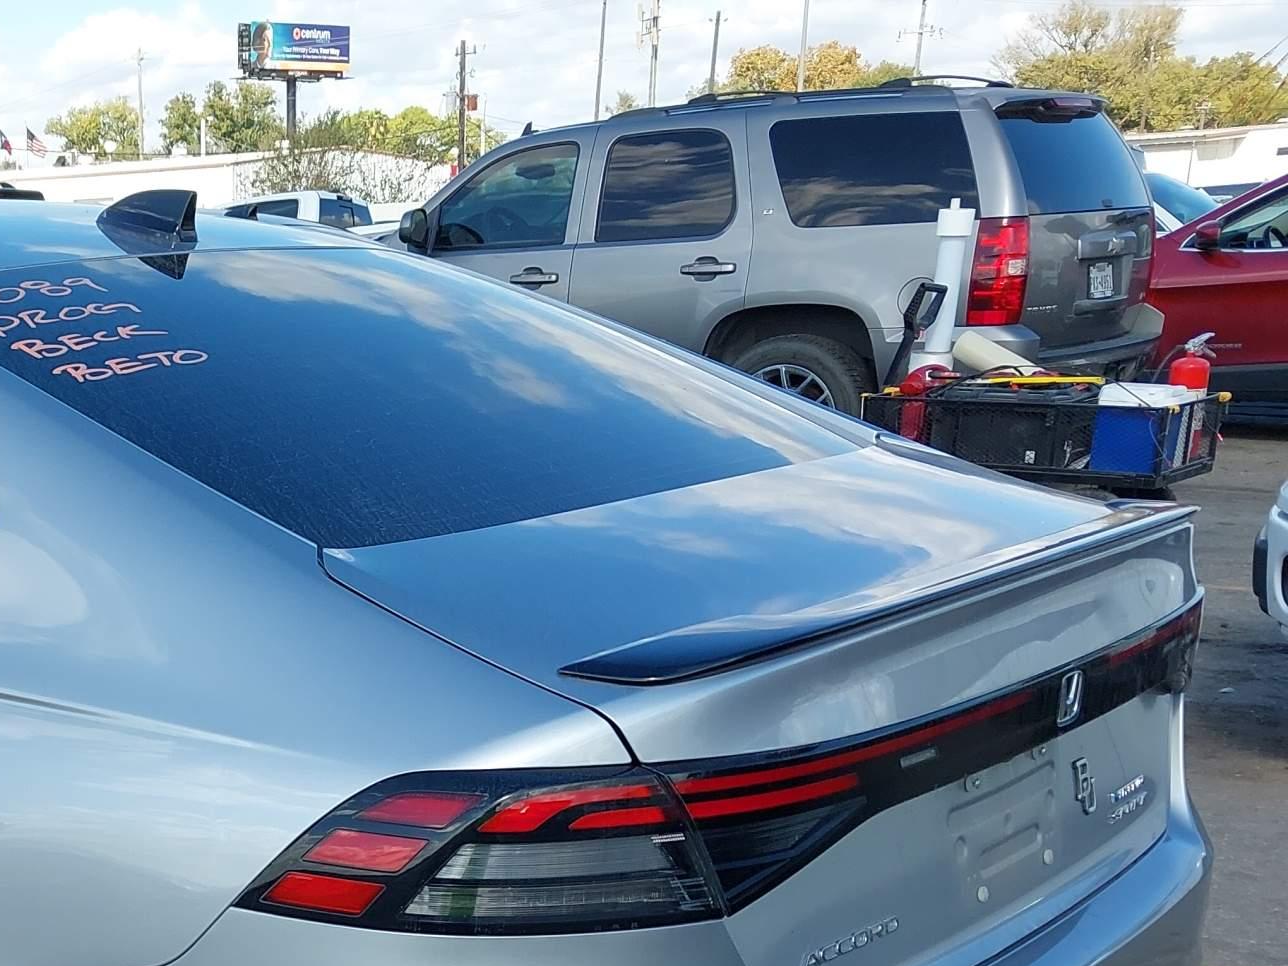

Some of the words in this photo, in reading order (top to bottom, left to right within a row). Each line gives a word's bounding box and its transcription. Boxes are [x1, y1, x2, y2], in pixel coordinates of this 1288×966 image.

[300, 28, 331, 41] centrum
[11, 324, 169, 359] BECK
[52, 349, 209, 383] BETO
